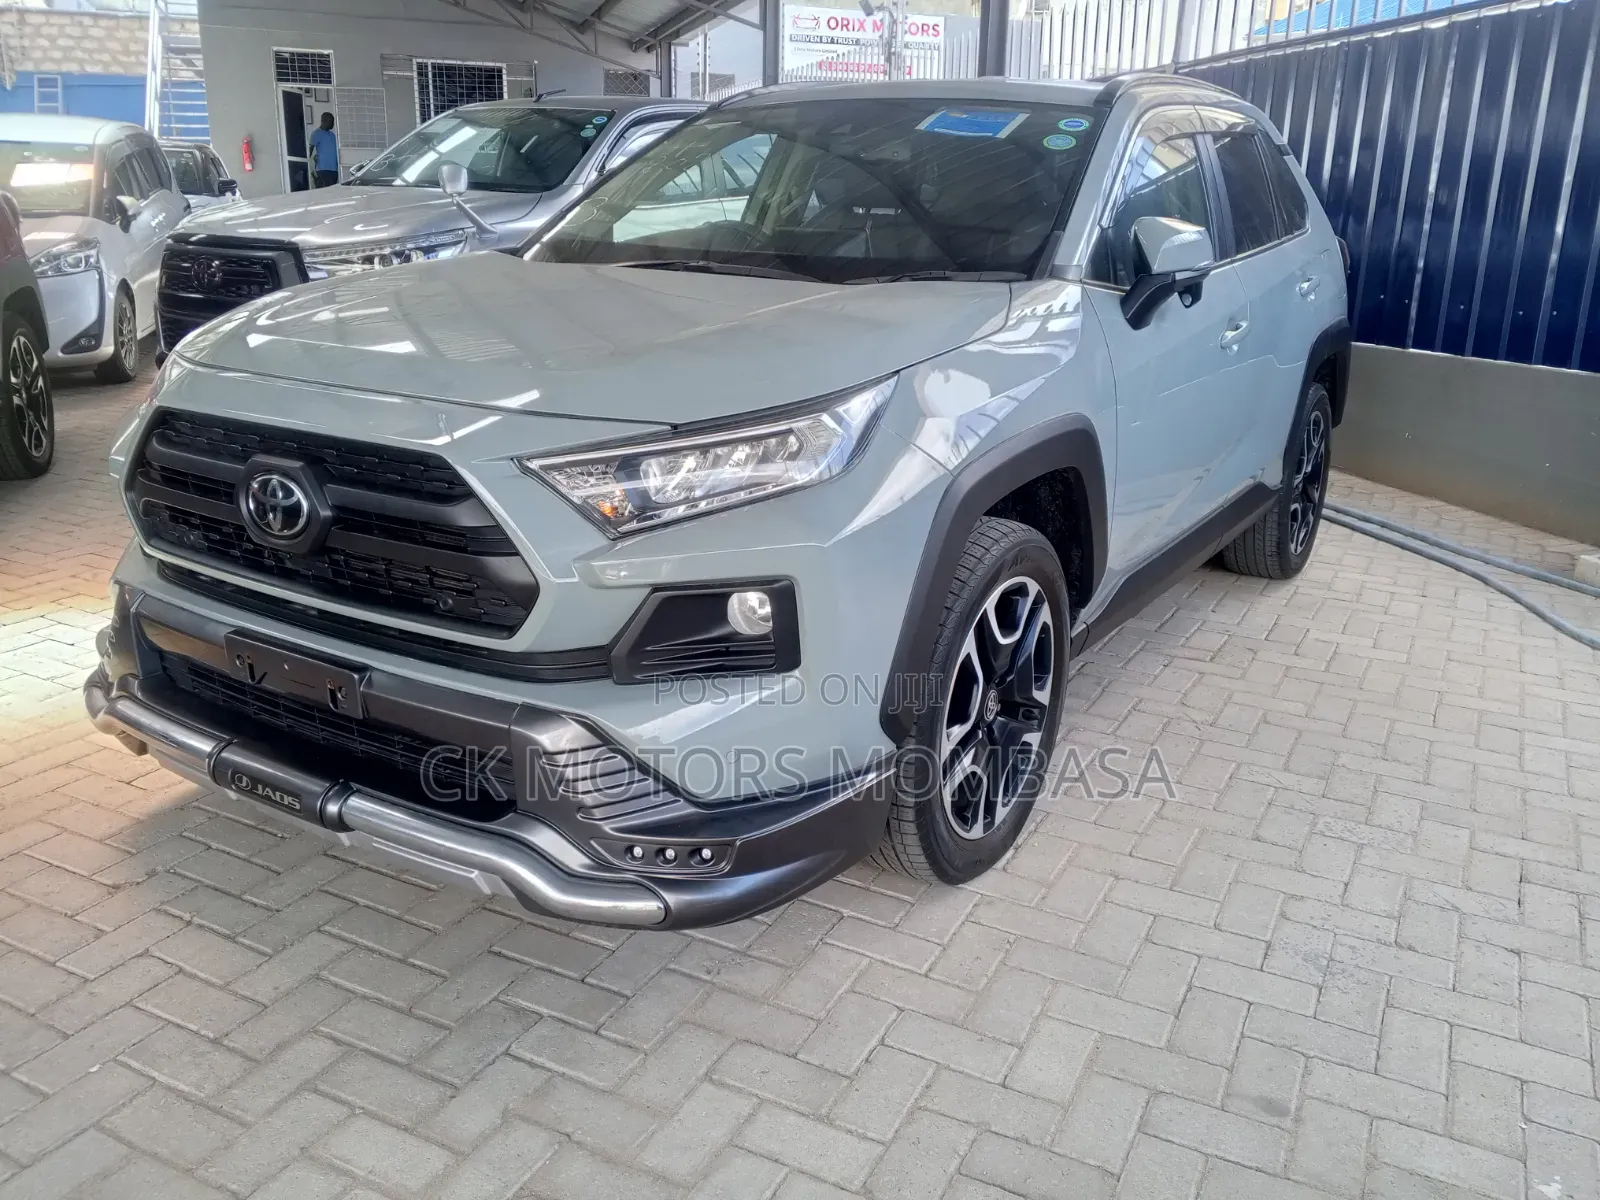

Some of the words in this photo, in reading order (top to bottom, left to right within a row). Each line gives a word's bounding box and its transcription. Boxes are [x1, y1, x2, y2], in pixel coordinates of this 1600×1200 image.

[827, 16, 867, 32] ORIX
[872, 21, 940, 37] MORS
[792, 34, 820, 42] DRIVEN
[832, 36, 857, 45] TRUST
[252, 784, 301, 810] JAOS
